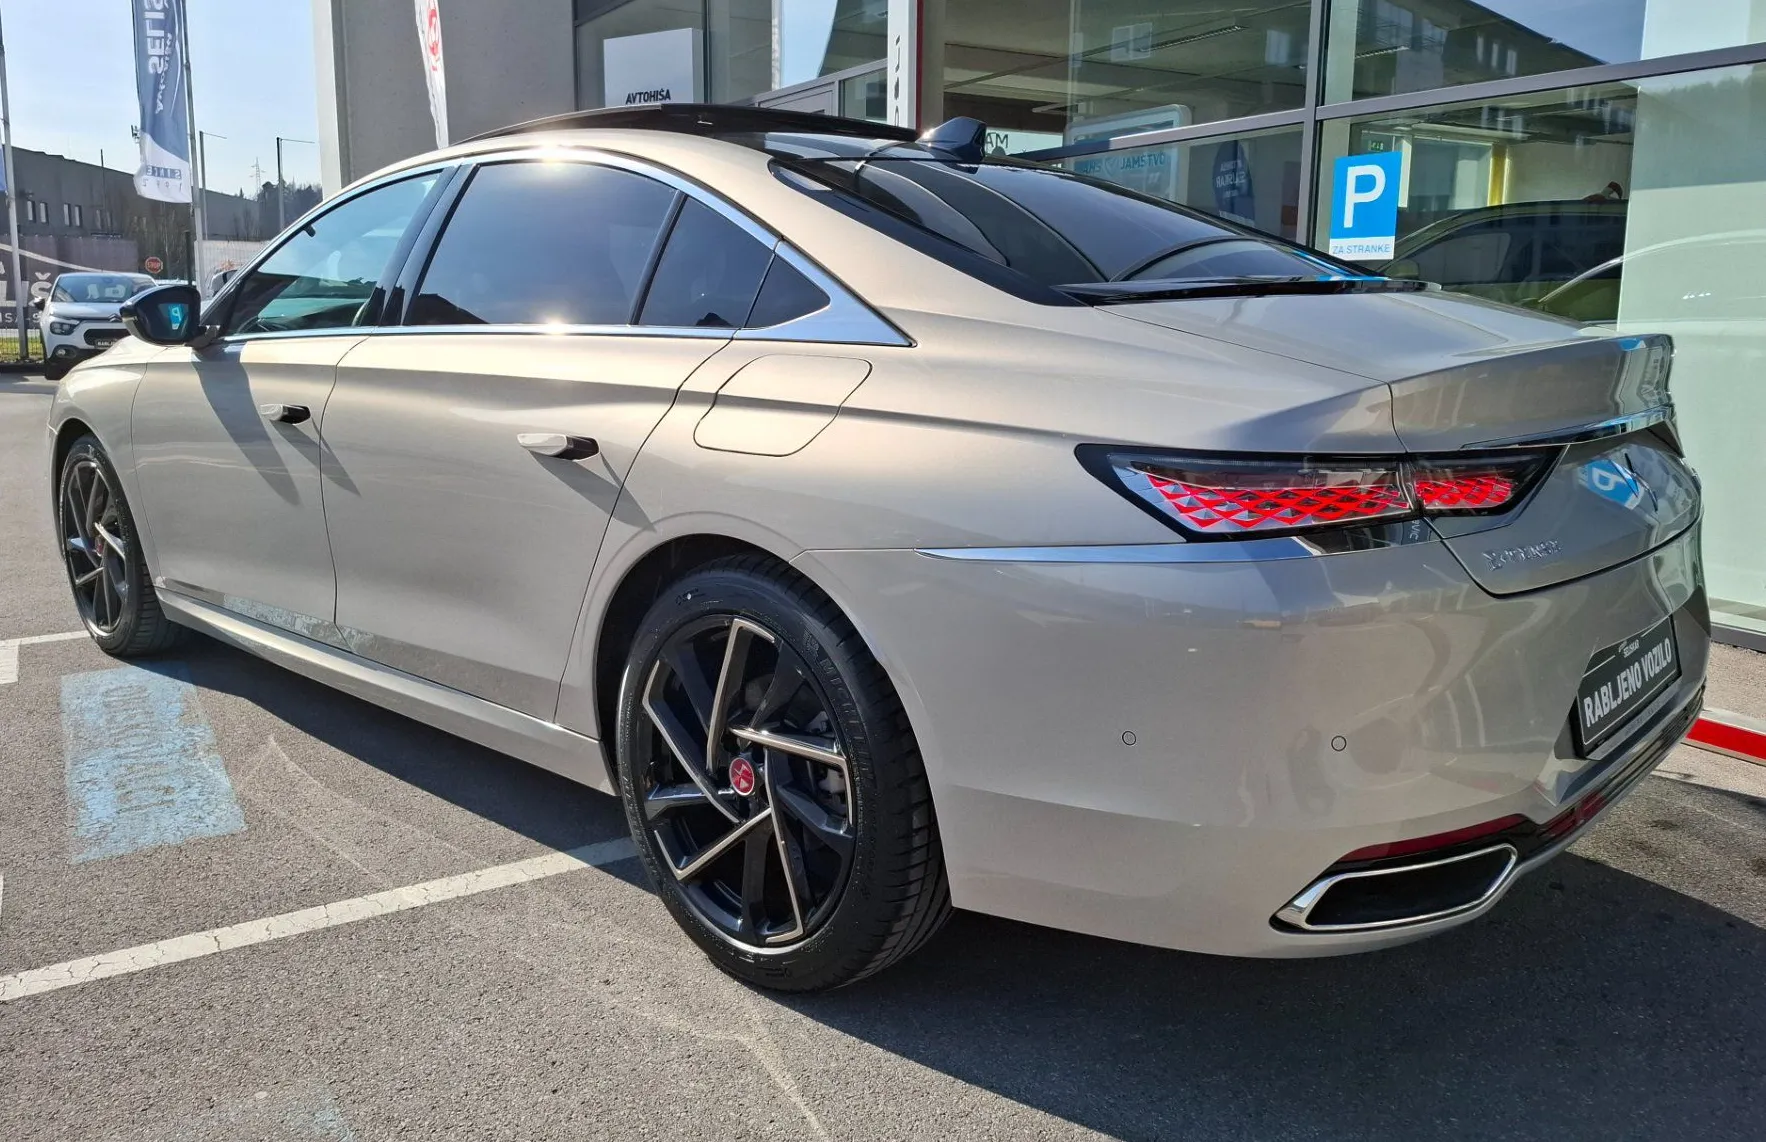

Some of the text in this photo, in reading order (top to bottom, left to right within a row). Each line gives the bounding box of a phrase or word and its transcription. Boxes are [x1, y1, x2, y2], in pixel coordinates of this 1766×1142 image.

[625, 88, 672, 105] AVTOHIŠA
[1343, 164, 1386, 228] P
[1332, 243, 1391, 255] ZA STRANKE
[1583, 637, 1672, 728] RABLJENO VOZILO
